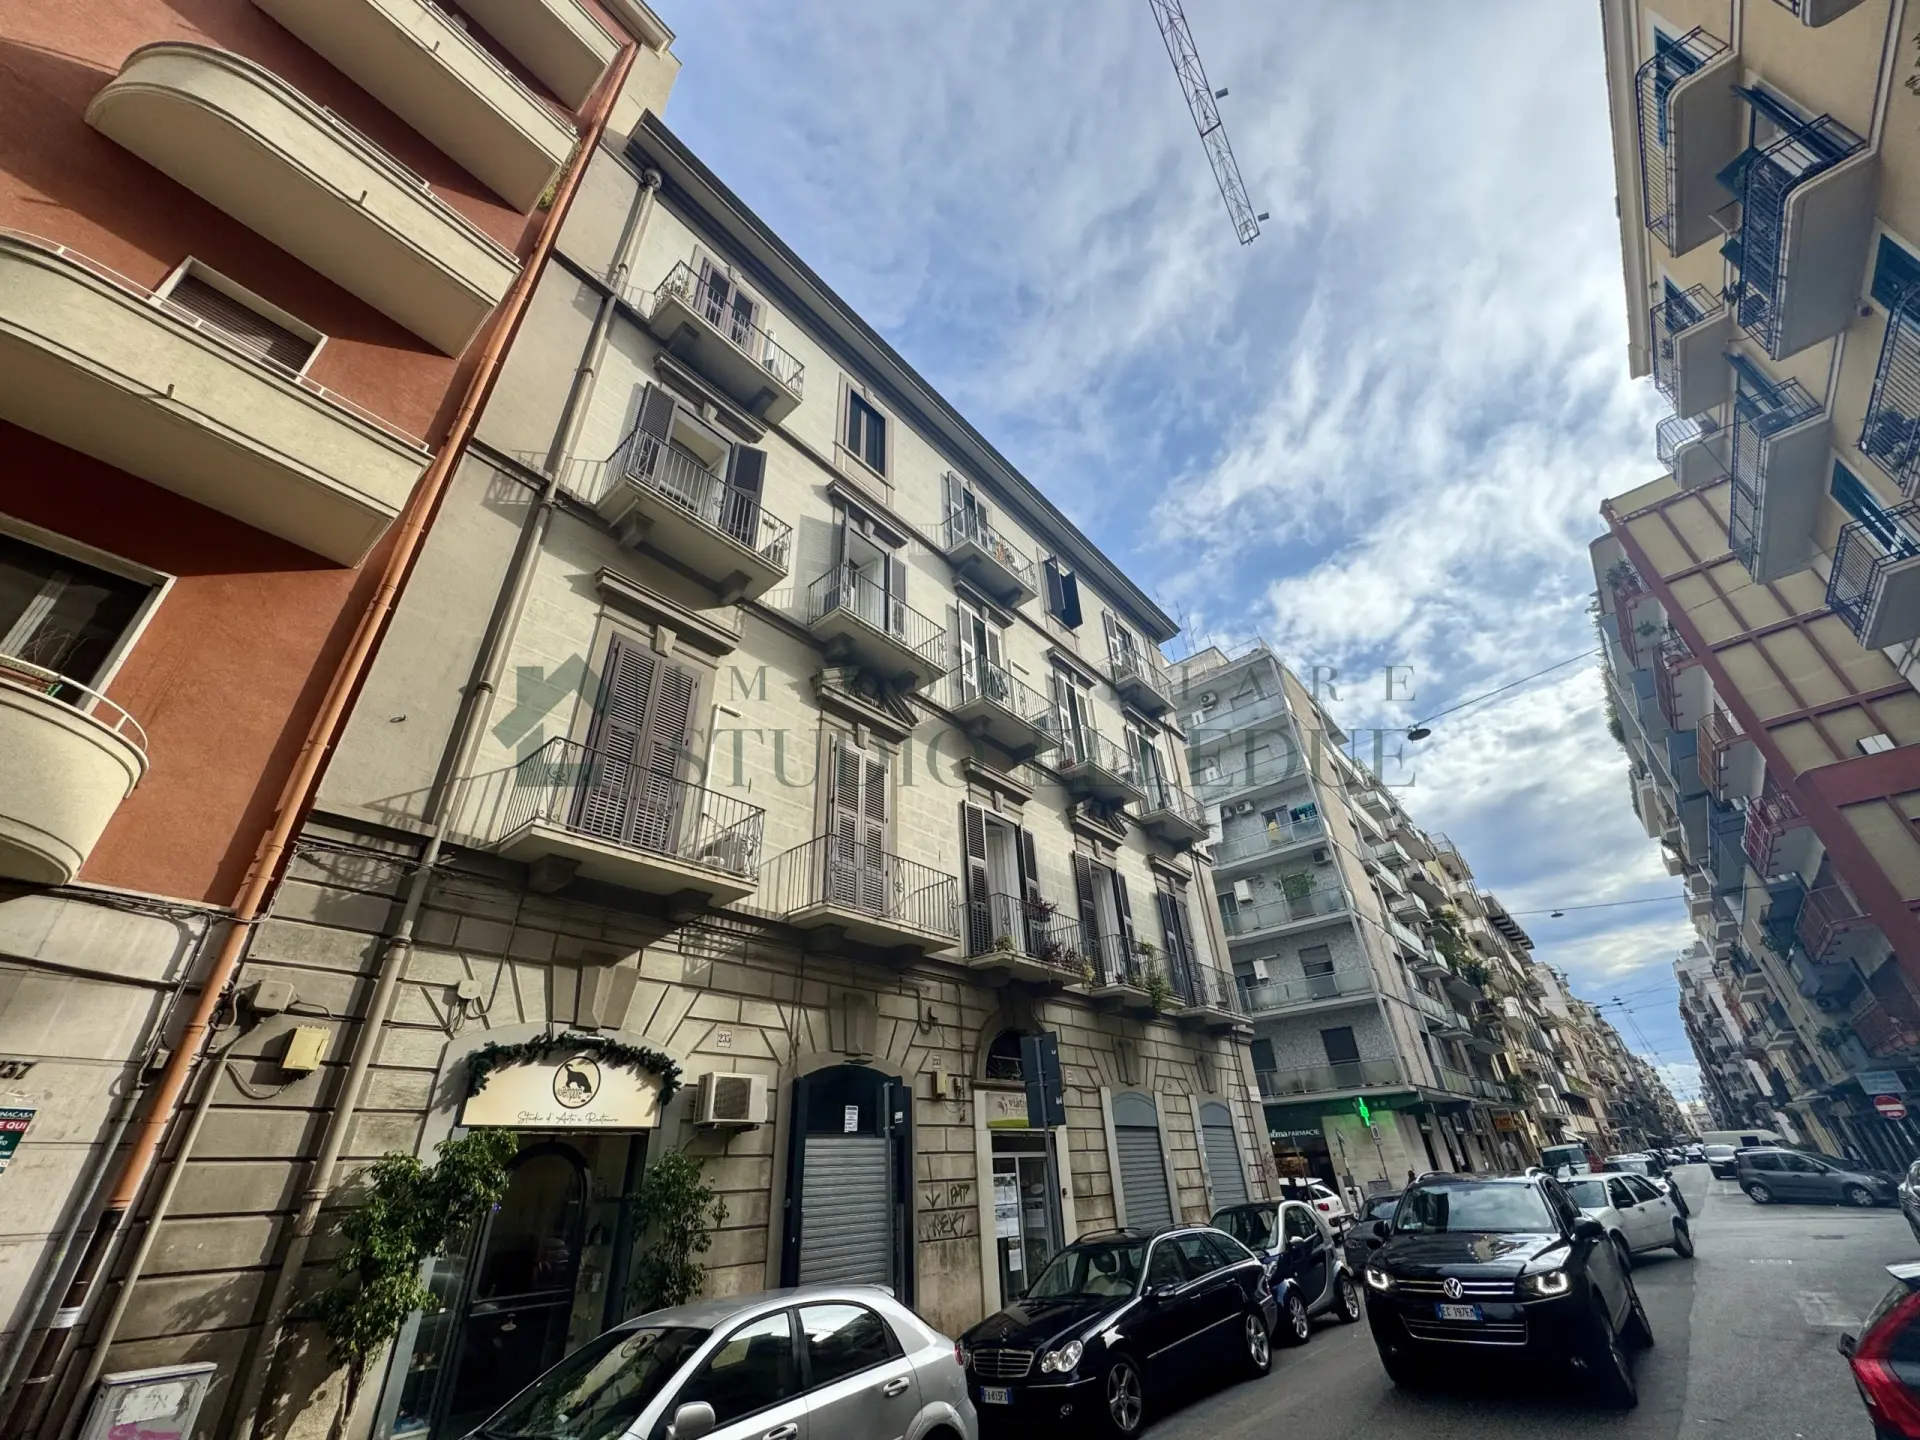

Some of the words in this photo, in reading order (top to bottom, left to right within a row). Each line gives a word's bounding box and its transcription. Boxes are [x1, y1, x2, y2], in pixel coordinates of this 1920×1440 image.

[0, 1110, 33, 1118] NACASA
[517, 1110, 544, 1124] Studio
[6, 1121, 28, 1130] QUI
[1287, 1128, 1320, 1137] FARMACIE
